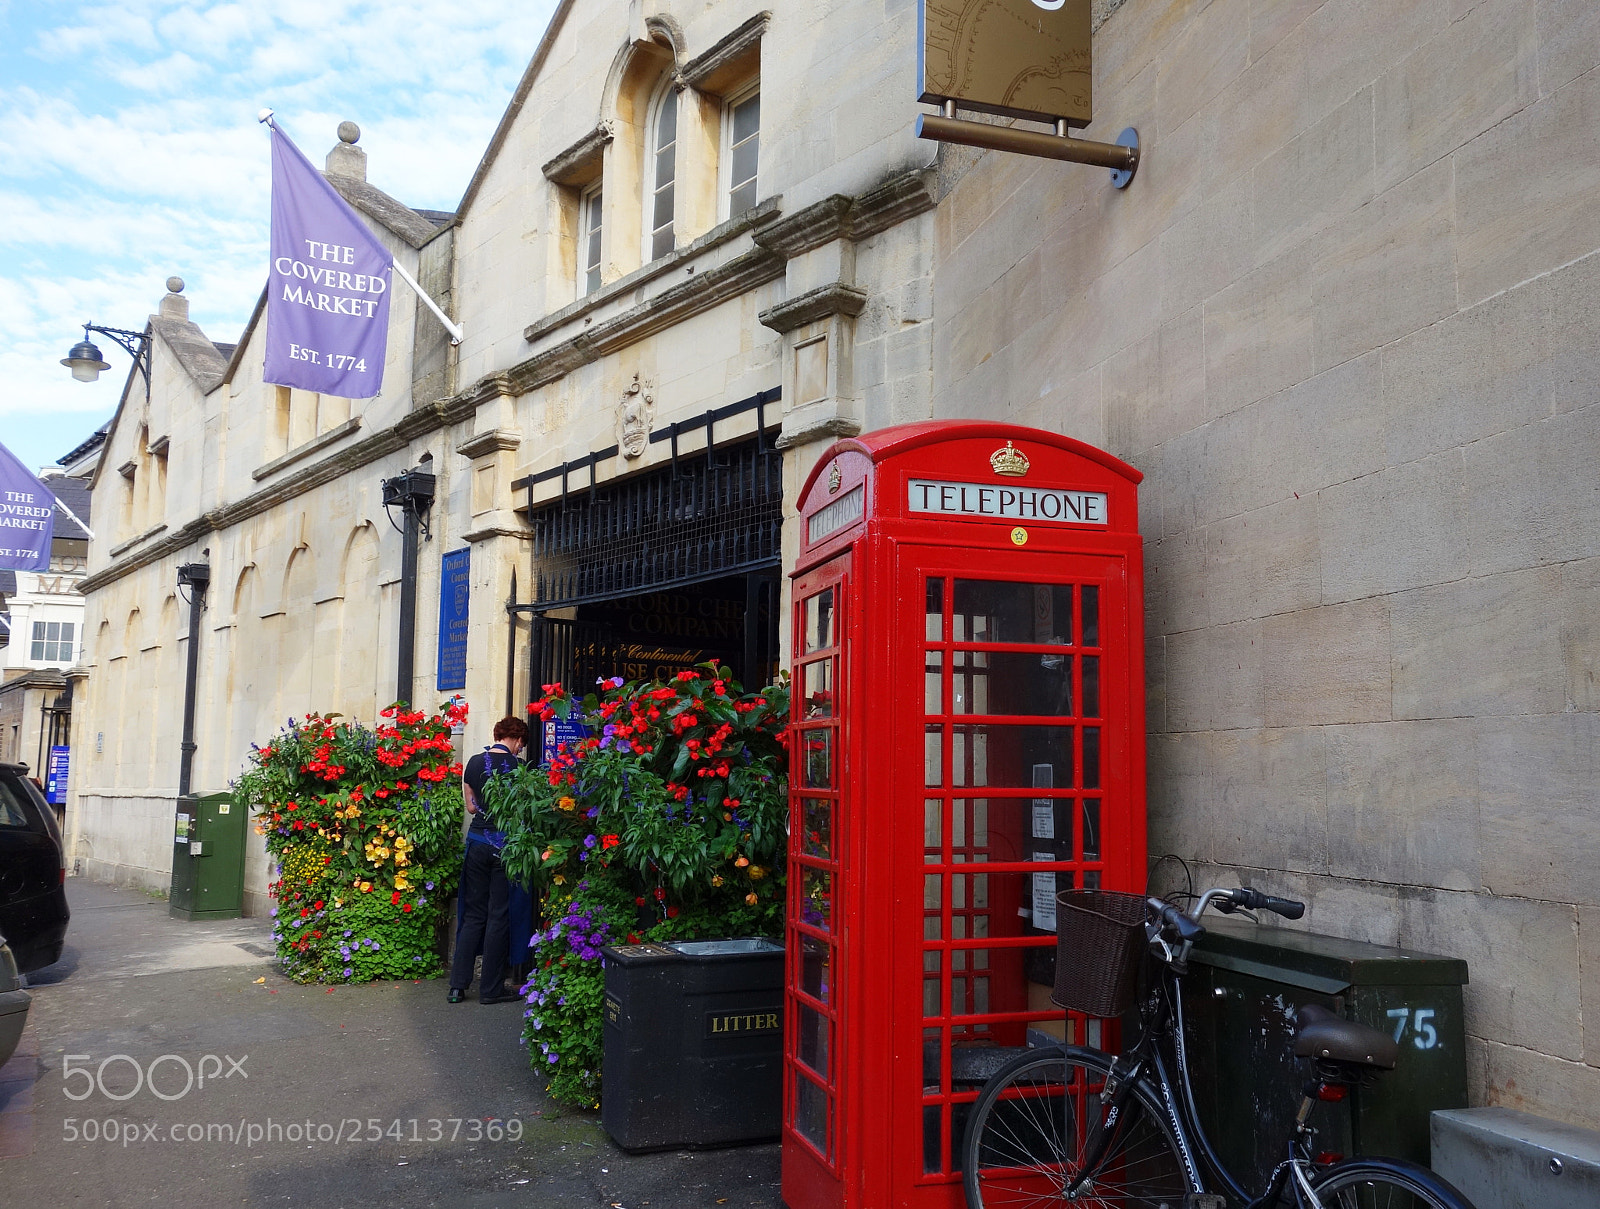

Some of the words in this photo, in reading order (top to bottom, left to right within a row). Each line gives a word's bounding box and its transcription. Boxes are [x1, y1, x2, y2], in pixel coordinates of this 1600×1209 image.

[305, 239, 355, 265] THE
[275, 257, 387, 294] COVERED
[282, 283, 378, 318] MARKET
[289, 343, 321, 365] EST.
[326, 353, 367, 373] 1774
[5, 491, 34, 503] THE
[915, 484, 1100, 521] TELEPHONE
[0, 503, 51, 518] OVERED
[811, 487, 863, 540] TELEPHONE
[0, 517, 46, 531] ARKET
[0, 548, 13, 556] ST.
[16, 549, 39, 559] 1774
[451, 571, 469, 583] Counci
[627, 644, 704, 663] Continental
[712, 1013, 779, 1033] LITTER
[1386, 1008, 1437, 1049] 75
